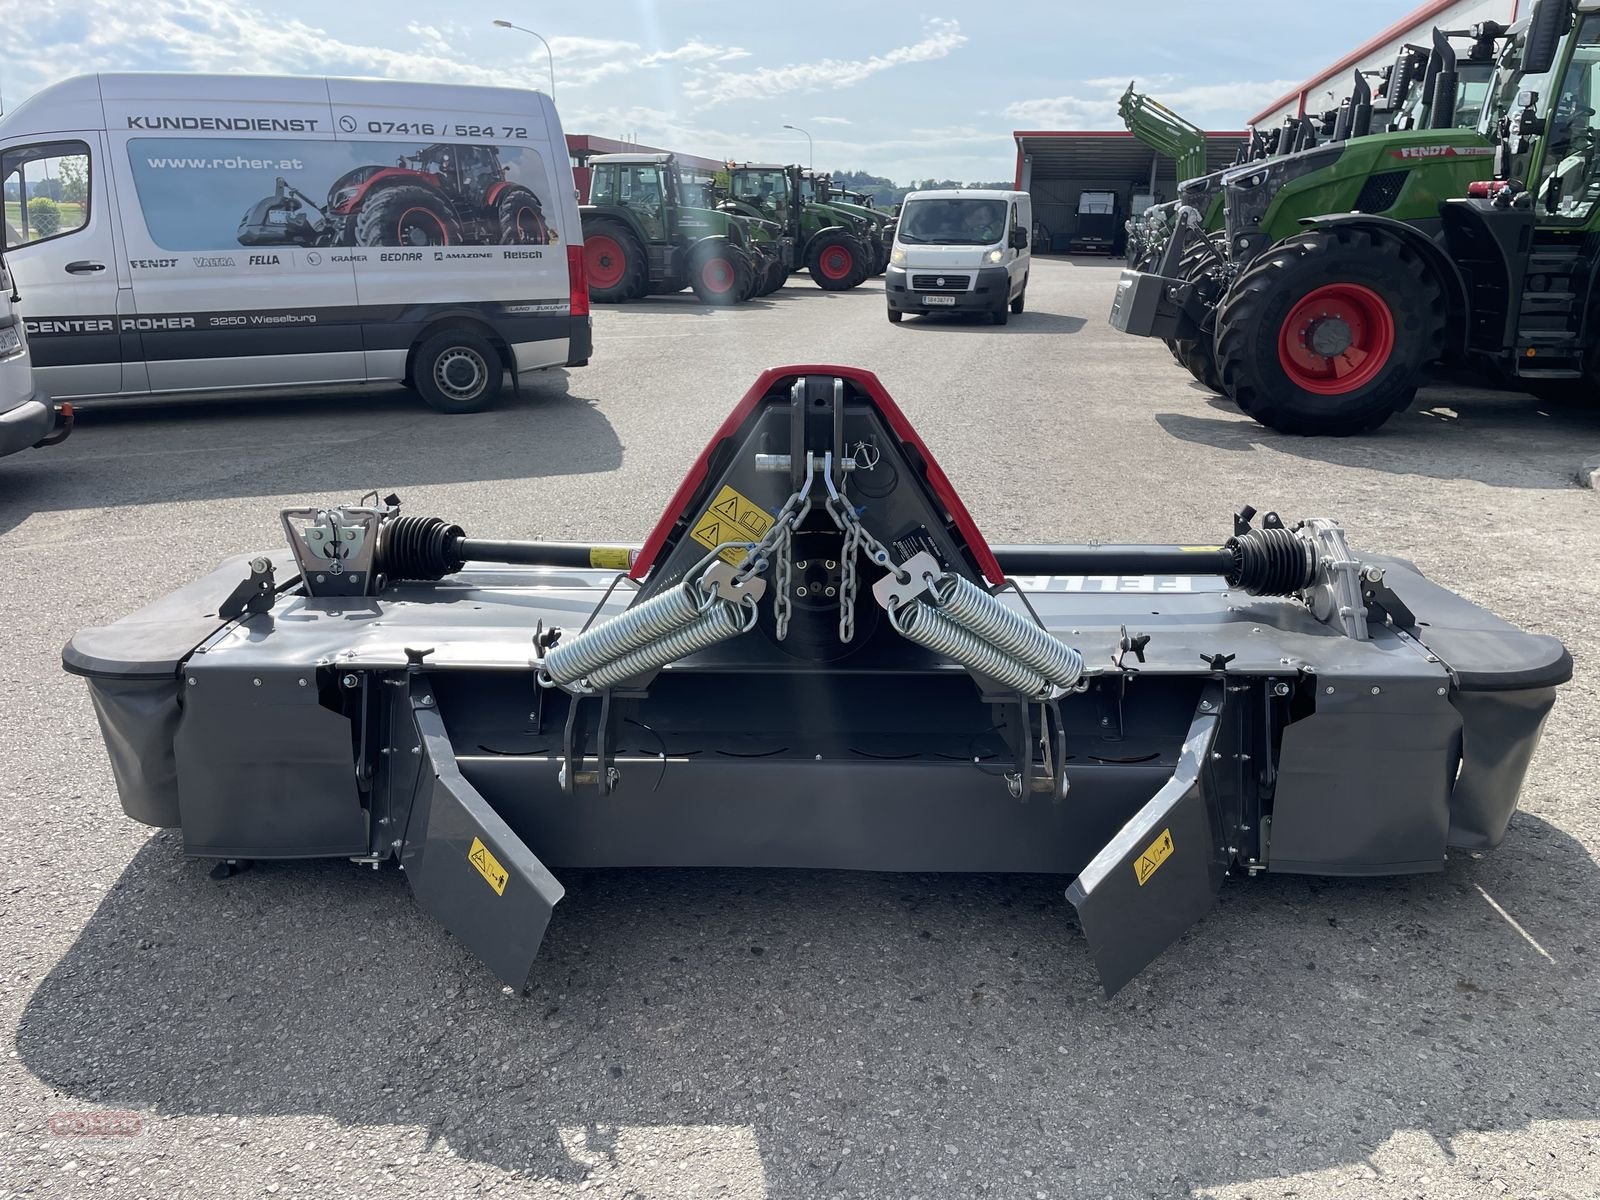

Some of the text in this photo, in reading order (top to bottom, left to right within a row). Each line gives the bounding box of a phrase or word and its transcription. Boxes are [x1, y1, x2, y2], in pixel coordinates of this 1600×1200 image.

[127, 116, 319, 132] KUNDENDIENST
[367, 121, 528, 139] 07416 / 524 72
[1401, 146, 1448, 157] FENDT
[147, 156, 304, 170] www.roher.at
[249, 255, 281, 265] FELLA
[331, 255, 368, 263] KRAMER
[380, 252, 423, 262] BEDNAR
[445, 252, 493, 260] AMAZONE
[503, 251, 543, 260] Reisch
[130, 258, 179, 269] FENDT
[193, 256, 236, 268] VALTRA
[25, 317, 196, 334] CENTER ROHER
[209, 313, 317, 327] 3250 Wieselburg
